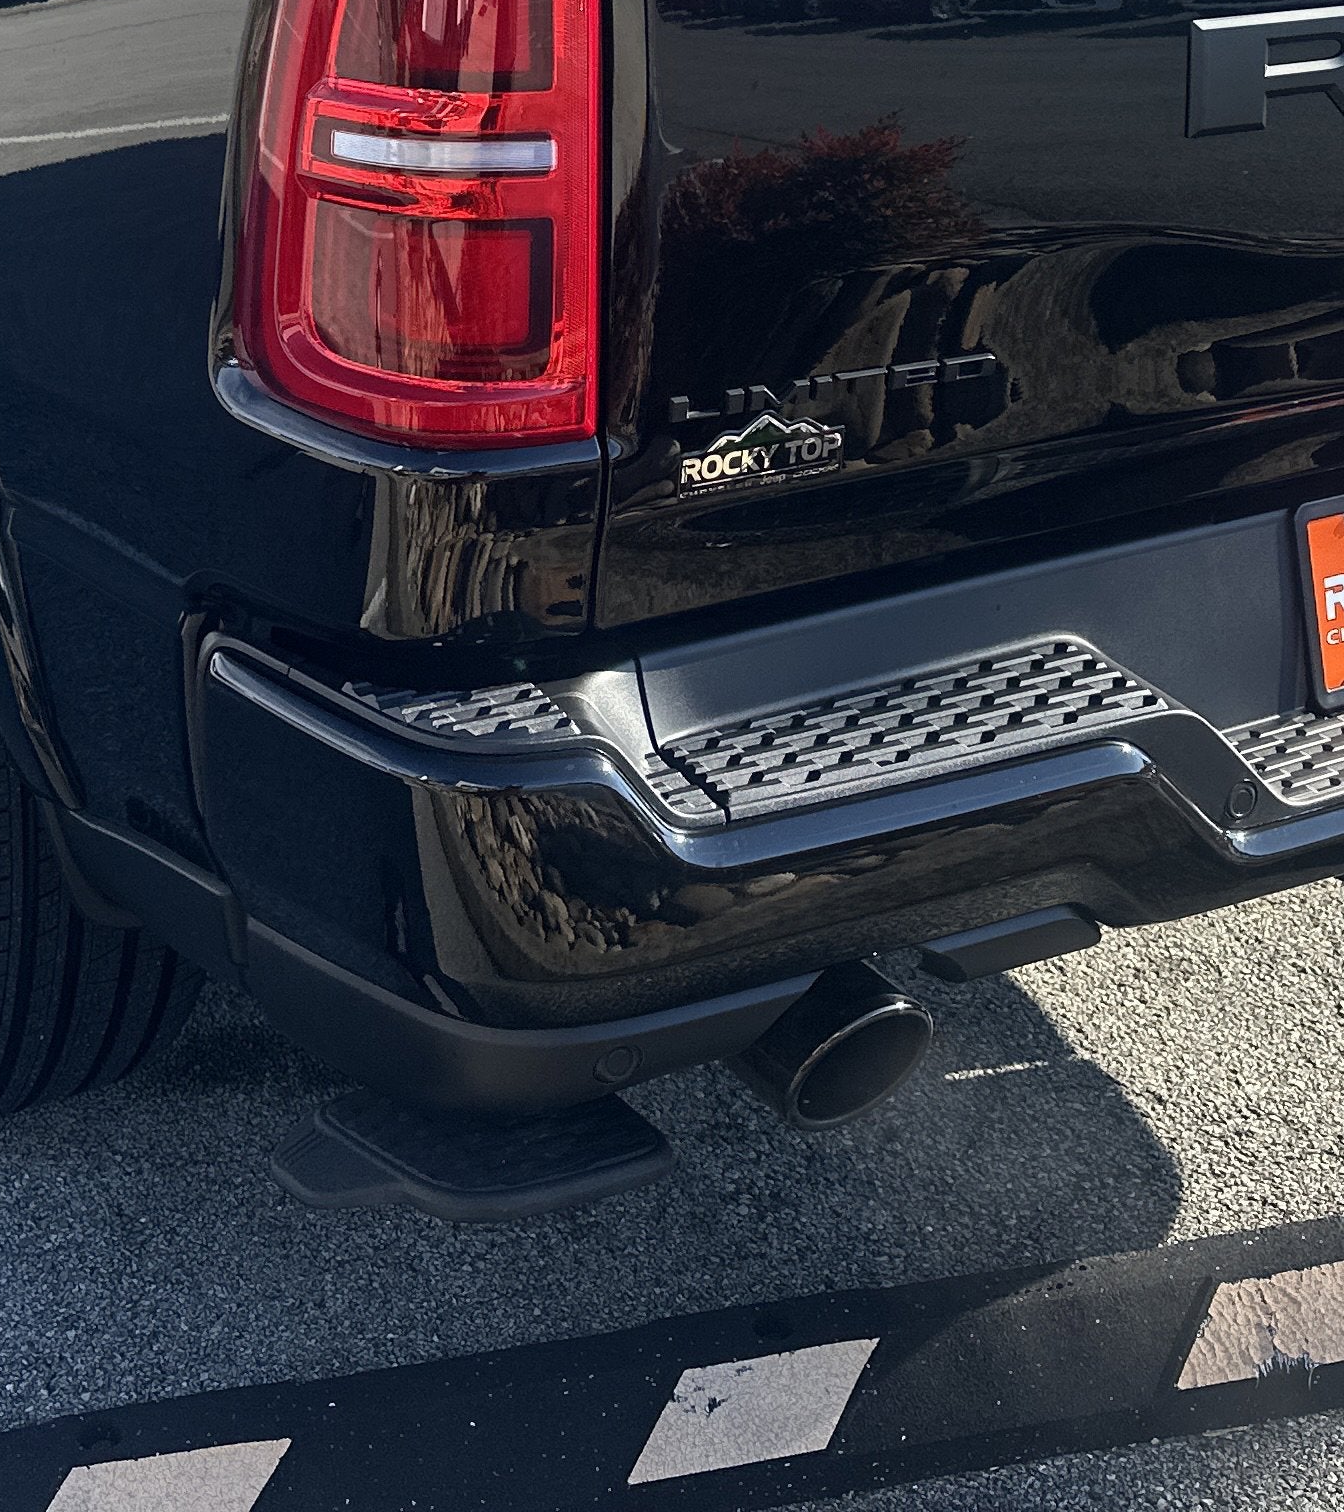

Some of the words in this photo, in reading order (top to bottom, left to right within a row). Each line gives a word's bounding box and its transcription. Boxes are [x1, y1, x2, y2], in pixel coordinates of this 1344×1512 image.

[681, 443, 780, 484] ROCKY
[784, 433, 842, 464] TOP
[759, 473, 786, 486] Jeep
